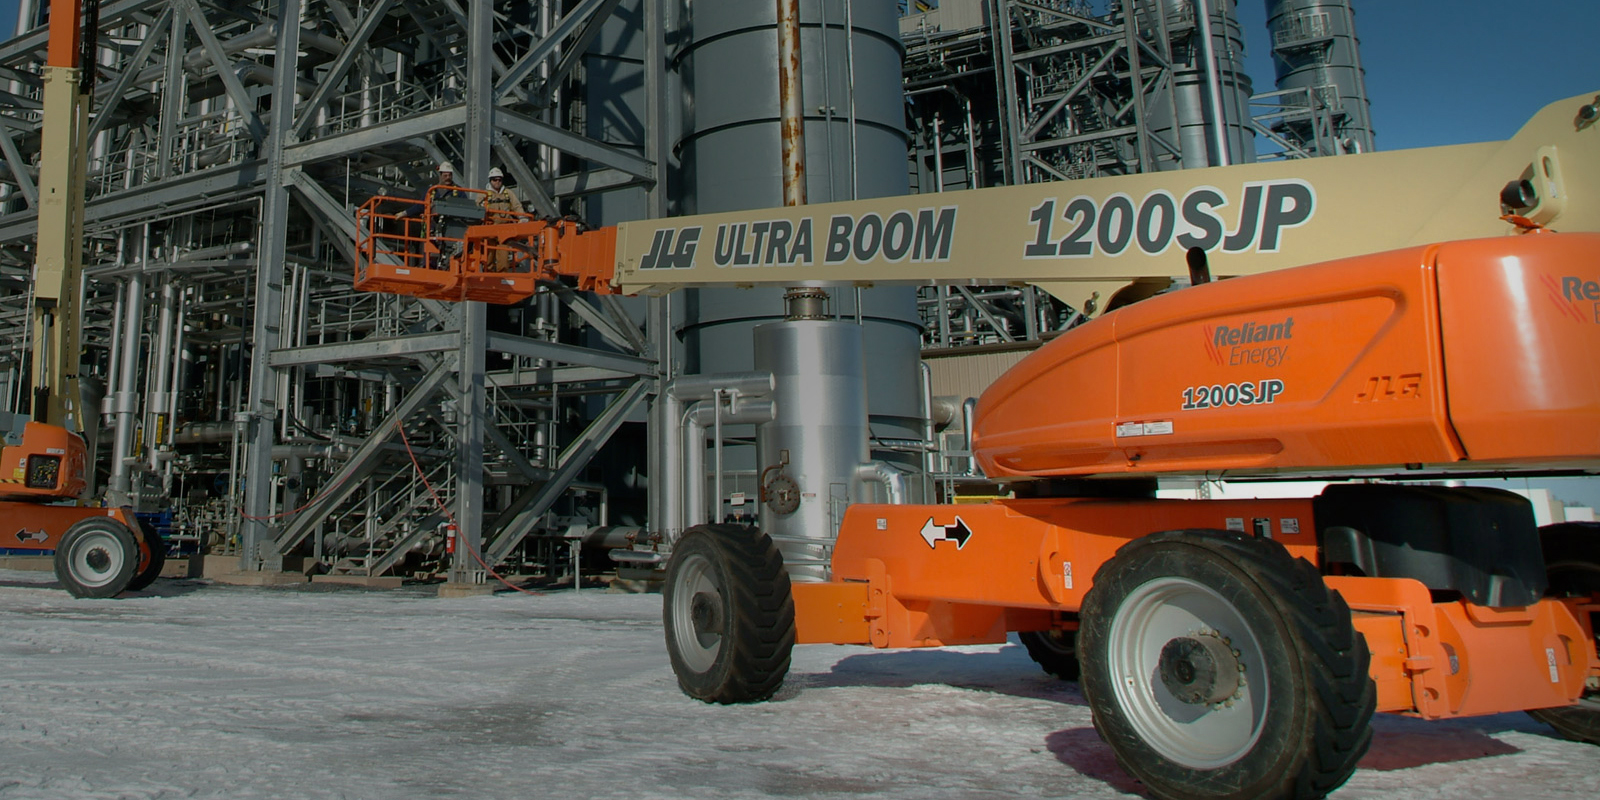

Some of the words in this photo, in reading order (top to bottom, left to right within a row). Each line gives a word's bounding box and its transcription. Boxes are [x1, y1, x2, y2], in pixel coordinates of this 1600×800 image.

[639, 227, 703, 270] JLG
[714, 217, 813, 268] ULTRA
[823, 205, 958, 265] BOOM
[1023, 179, 1315, 259] 1200SJP
[1213, 316, 1294, 347] Reliant
[1229, 345, 1289, 368] Energy
[1181, 379, 1284, 410] 1200SJP
[1354, 372, 1422, 403] JLG
